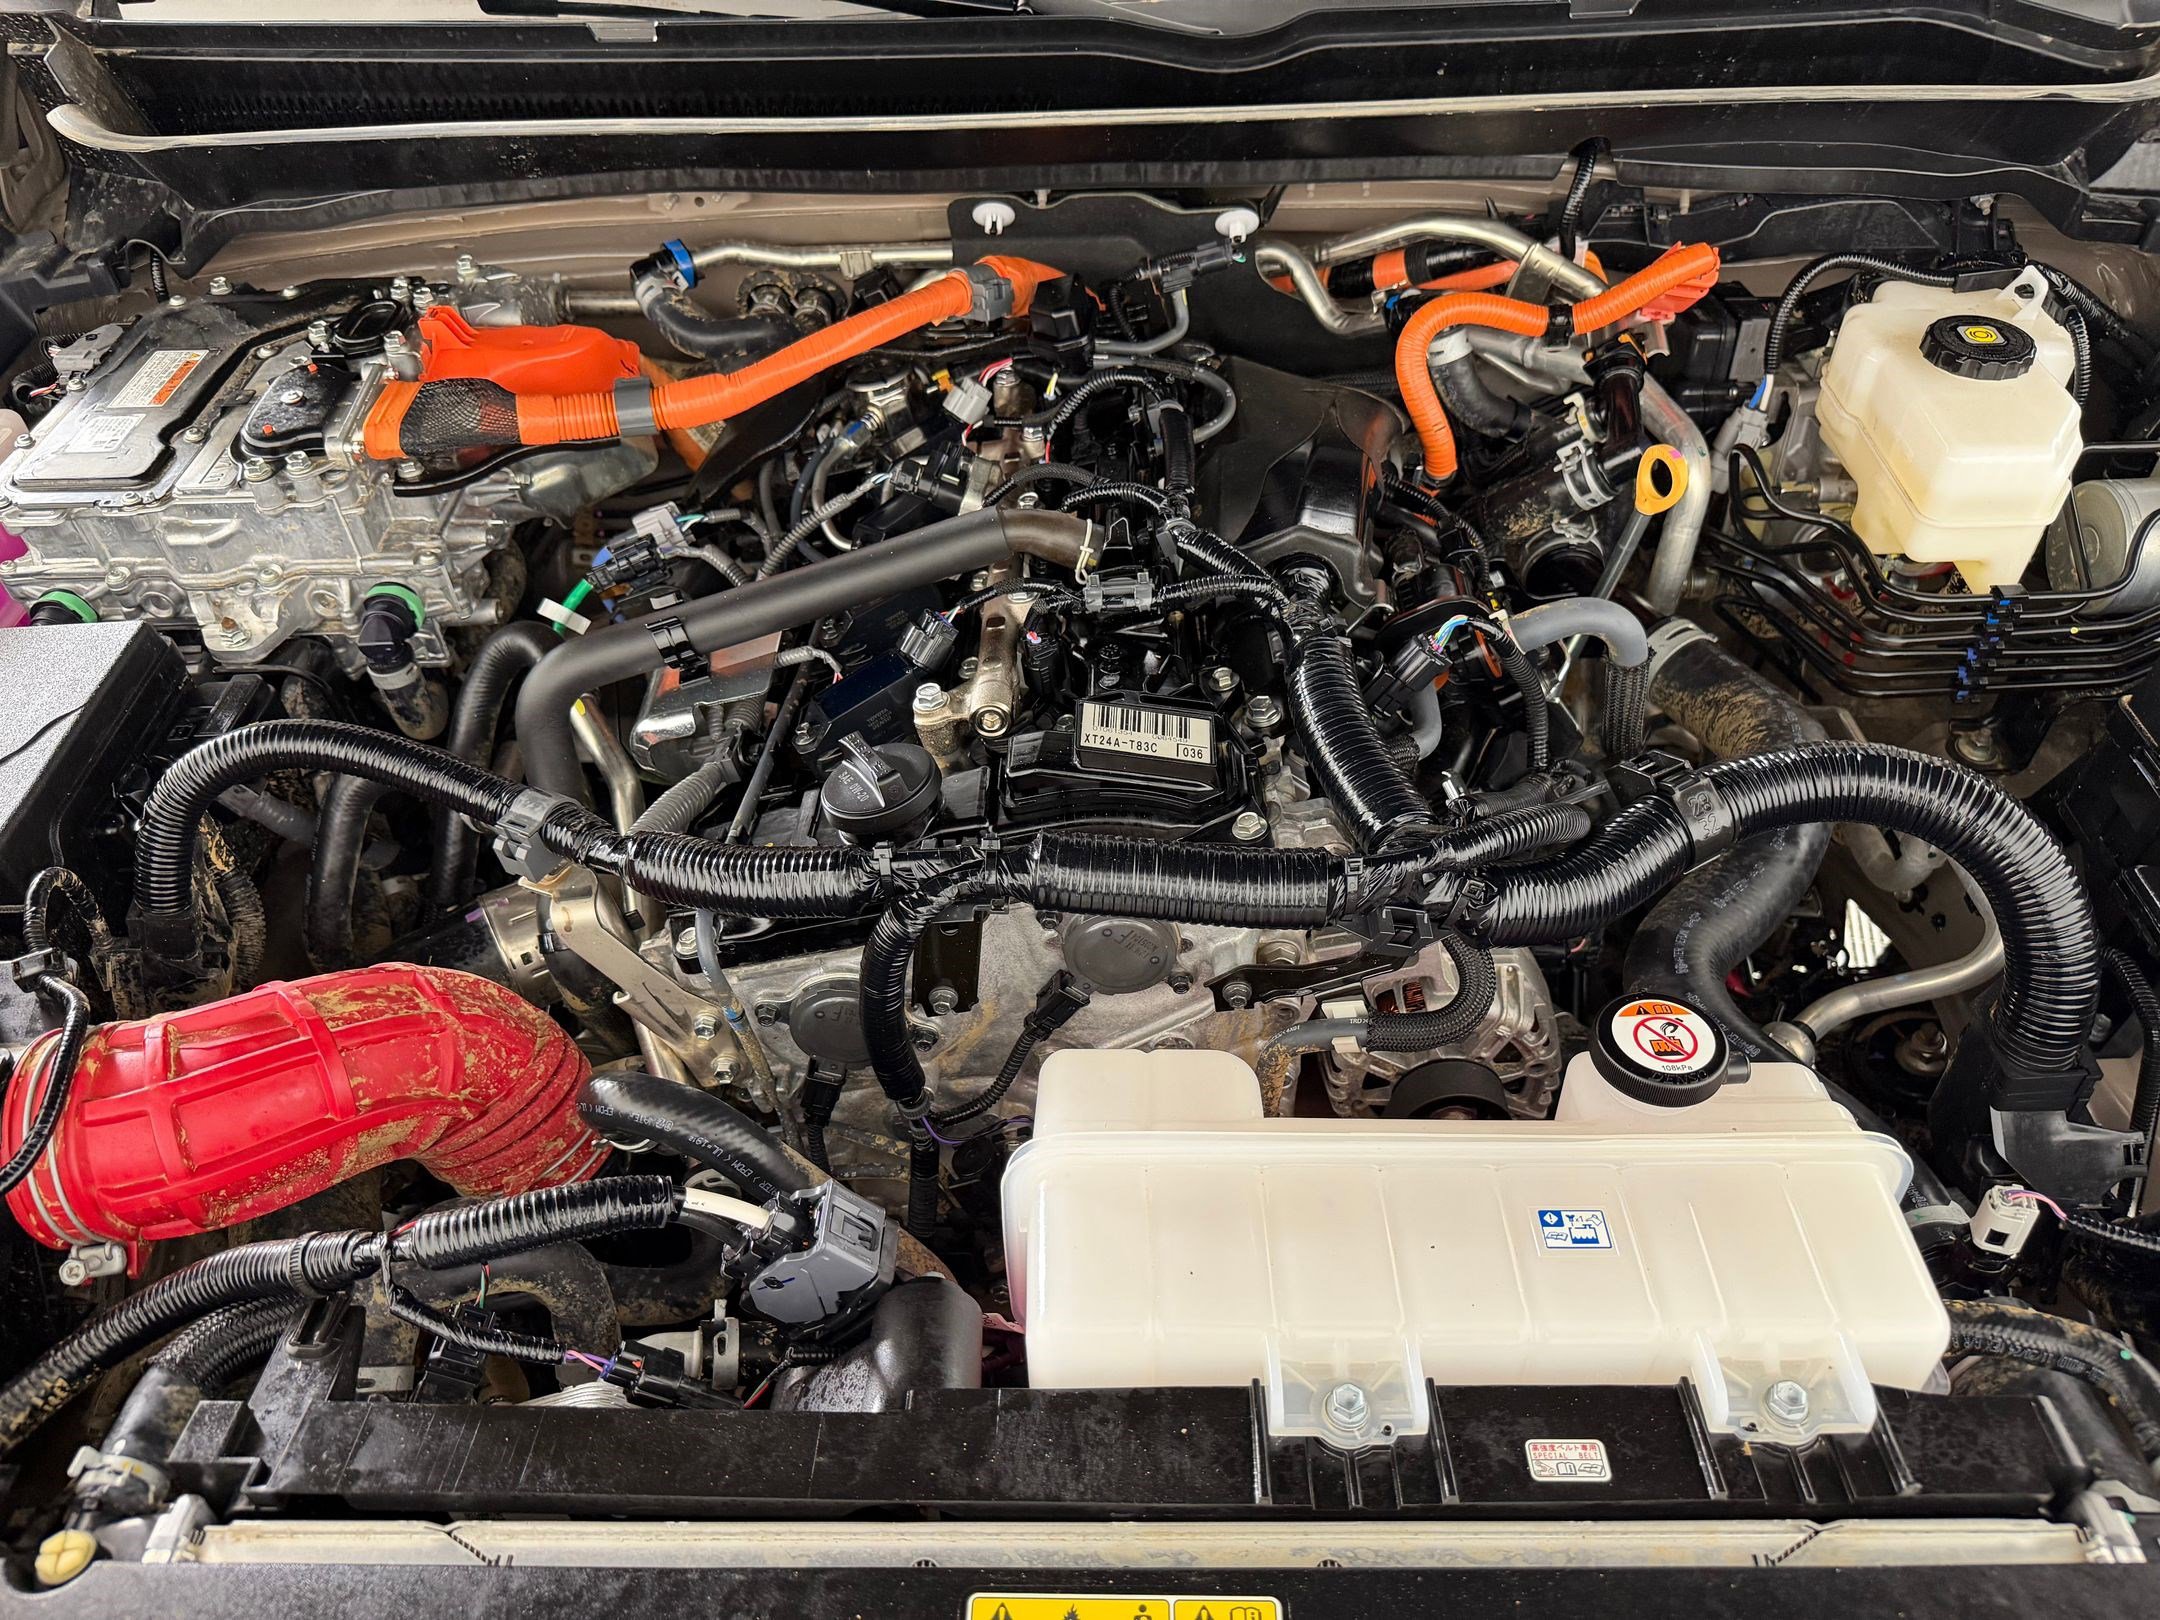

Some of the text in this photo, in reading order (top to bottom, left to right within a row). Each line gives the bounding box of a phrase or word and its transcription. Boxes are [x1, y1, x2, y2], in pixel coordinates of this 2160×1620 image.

[1083, 732, 1204, 760] XT24A-T83C 036
[837, 769, 853, 786] SAE
[849, 782, 870, 803] 0W-20
[1649, 1069, 1710, 1086] DENSO
[1660, 1064, 1694, 1072] 108kPa
